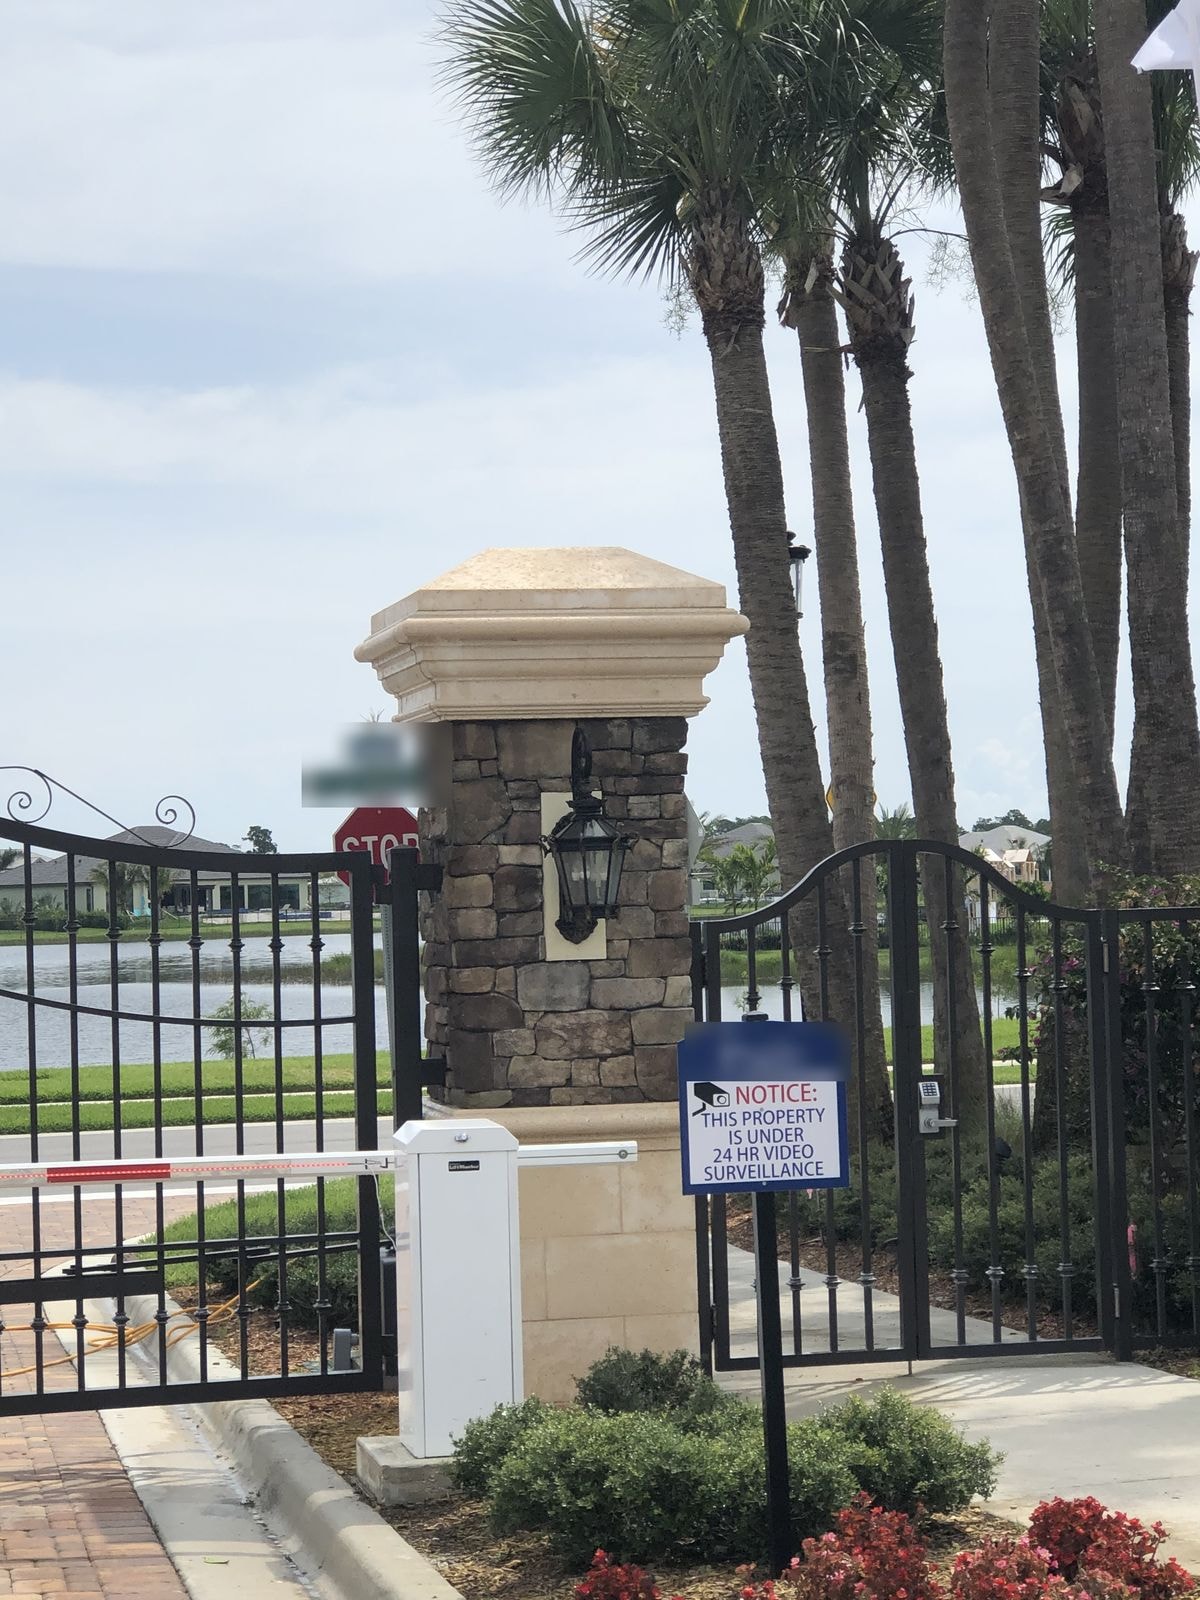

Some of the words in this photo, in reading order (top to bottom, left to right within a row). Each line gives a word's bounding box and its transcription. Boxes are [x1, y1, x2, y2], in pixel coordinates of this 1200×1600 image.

[736, 1083, 817, 1104] NOTICE:
[702, 1112, 737, 1128] THIS
[742, 1108, 825, 1125] PROPERTY
[729, 1130, 742, 1145] IS
[748, 1128, 804, 1144] UNDER
[713, 1149, 732, 1163] 24
[738, 1147, 759, 1161] HR
[764, 1144, 814, 1160] VIDEO
[704, 1161, 824, 1181] SURVEILLANCE
